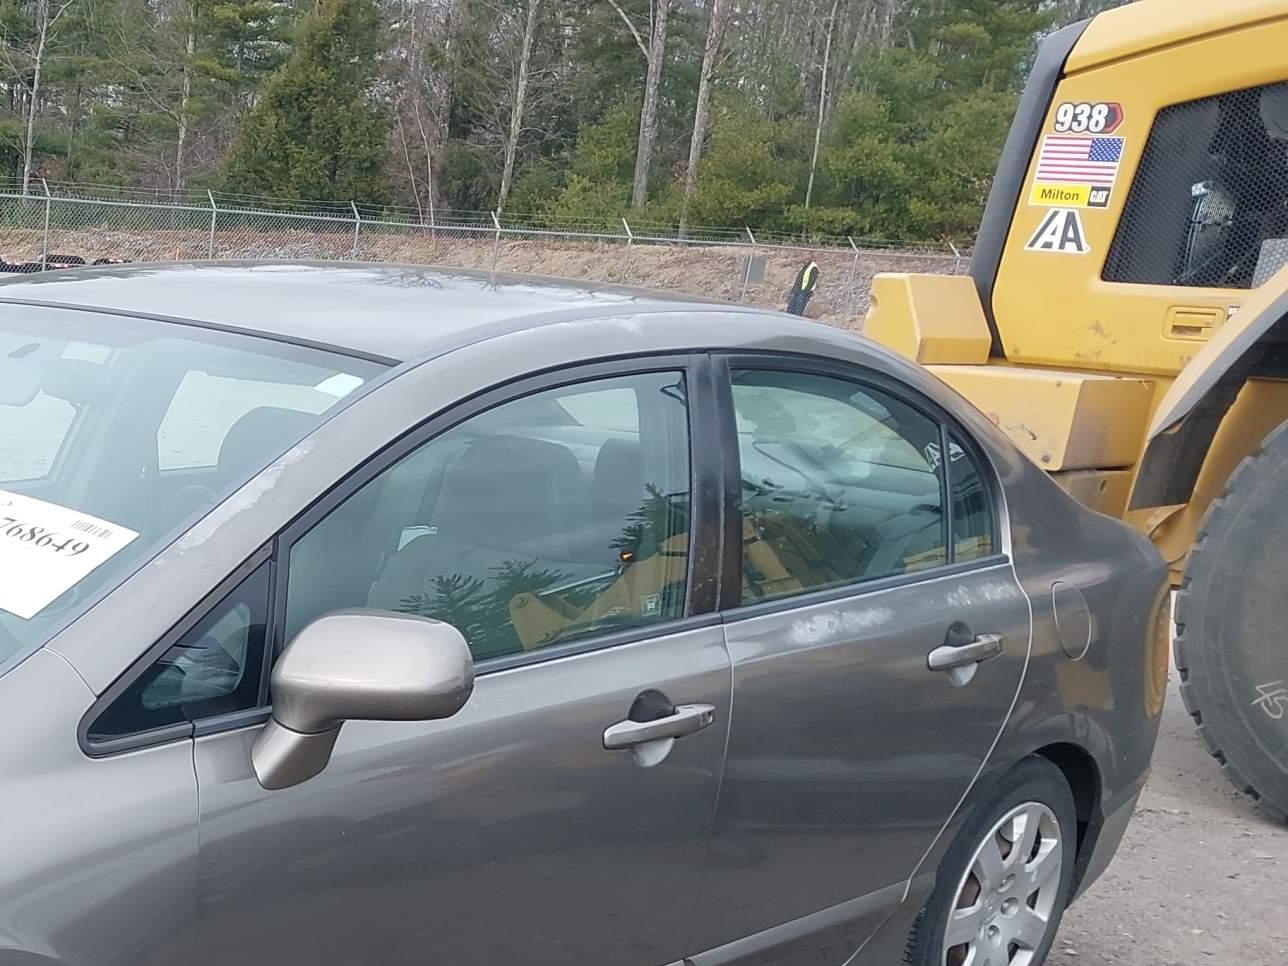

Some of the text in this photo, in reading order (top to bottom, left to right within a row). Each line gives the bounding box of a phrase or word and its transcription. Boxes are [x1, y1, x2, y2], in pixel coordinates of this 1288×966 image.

[1055, 103, 1109, 133] 938
[1040, 188, 1080, 201] Milton
[1089, 190, 1110, 203] CAT
